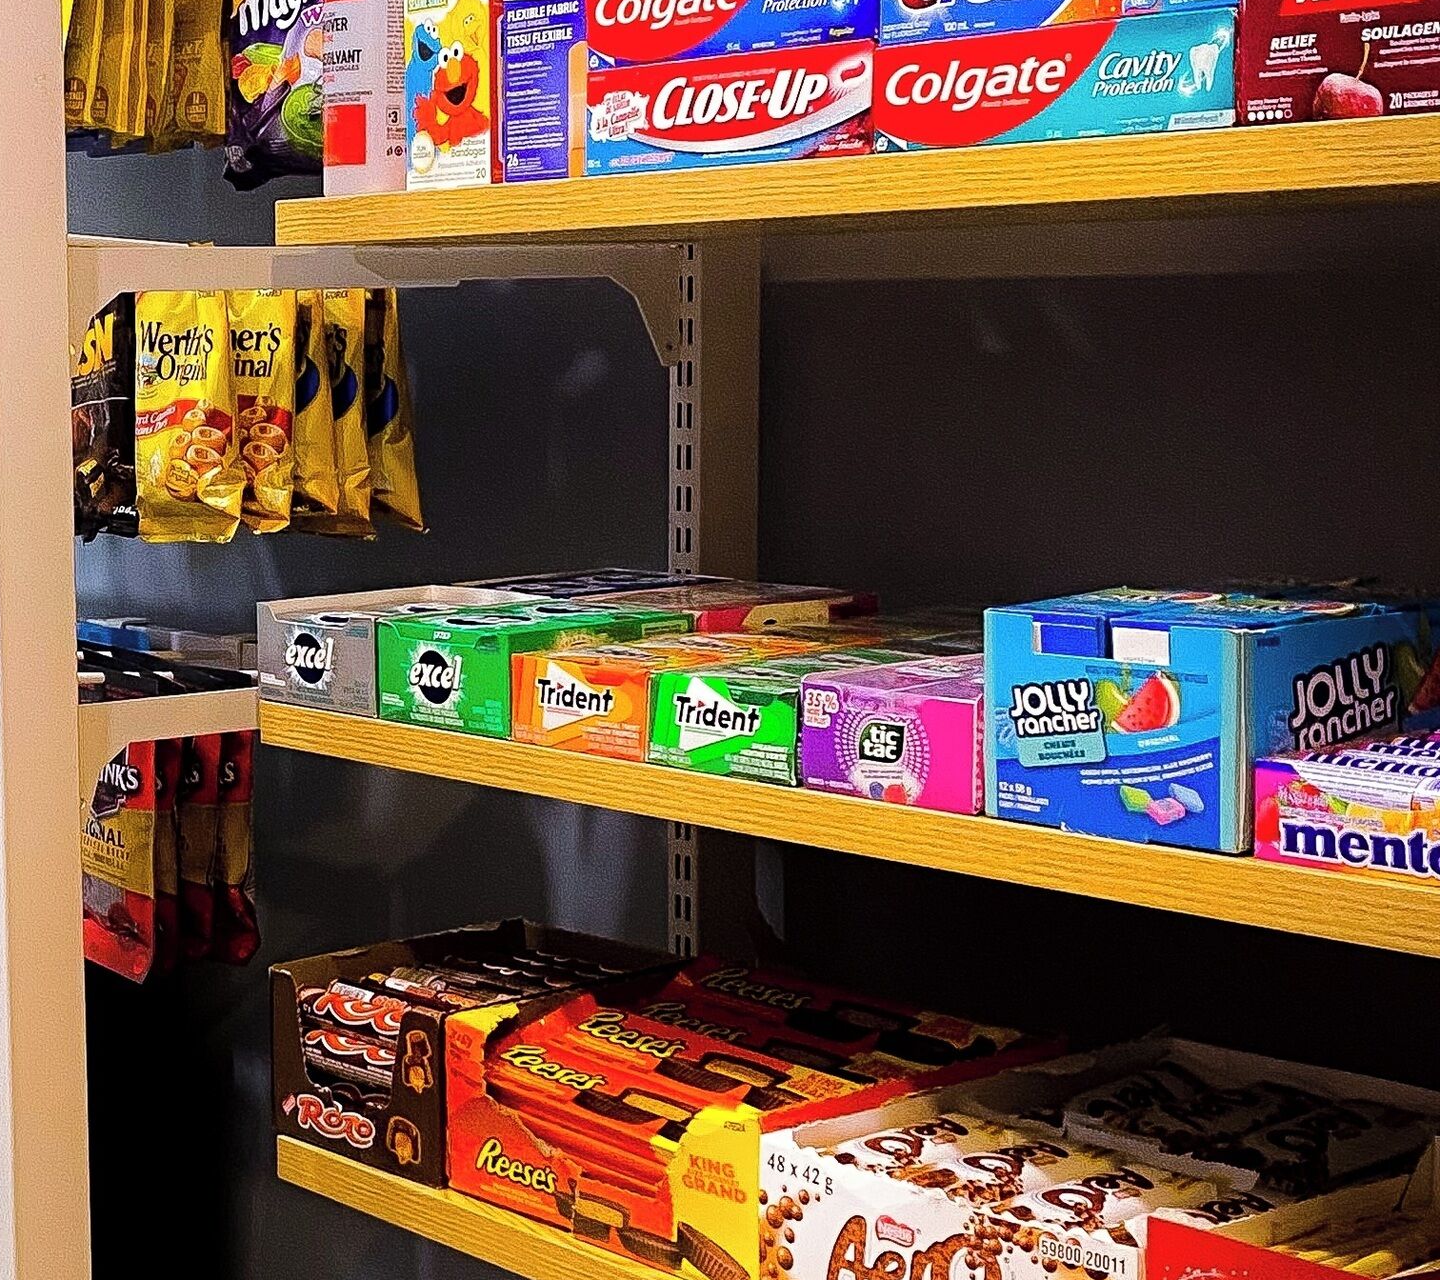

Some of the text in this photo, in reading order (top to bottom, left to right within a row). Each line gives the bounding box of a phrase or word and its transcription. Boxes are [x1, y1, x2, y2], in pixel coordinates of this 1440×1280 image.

[546, 0, 580, 18] FABRIC
[1270, 34, 1317, 51] RELIEF
[1097, 44, 1182, 82] Cavity
[885, 58, 1066, 112] Colgate
[1091, 76, 1175, 99] Protection
[1389, 93, 1402, 110] 20
[506, 154, 519, 168] 26
[285, 637, 334, 671] excel
[410, 655, 463, 690] excel
[1292, 647, 1385, 729] JOLLY
[537, 678, 614, 713] Trident
[1011, 682, 1090, 717] JOLLY
[676, 695, 759, 734] Trident
[1017, 710, 1099, 736] rancher
[1295, 688, 1396, 749] rancher
[862, 741, 898, 760] tac
[870, 725, 899, 745] tic
[578, 1012, 686, 1060] Reese's
[503, 1045, 608, 1091] Reese's
[476, 1139, 558, 1193] Reese's
[688, 1153, 737, 1177] KING
[767, 1152, 835, 1196] 48 x 42 g
[681, 1173, 748, 1205] GRAND
[1040, 1239, 1126, 1275] 59800 20011
